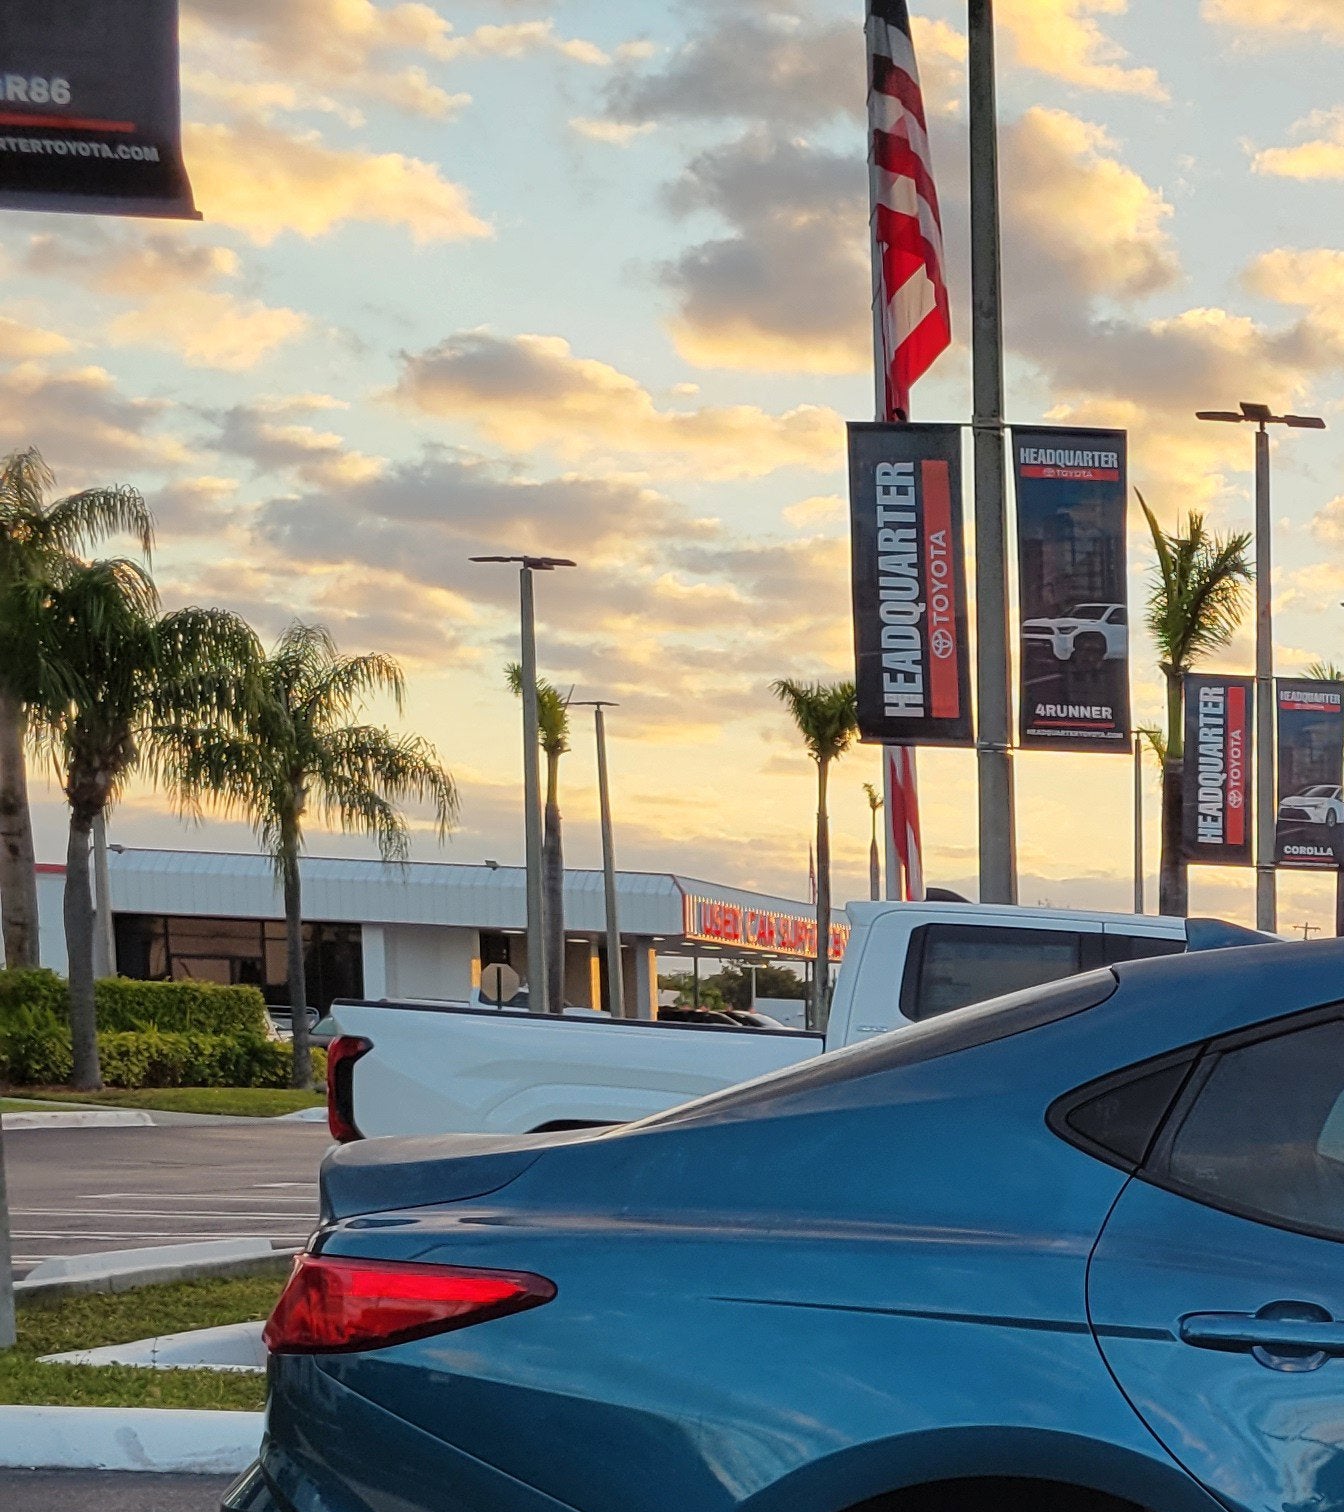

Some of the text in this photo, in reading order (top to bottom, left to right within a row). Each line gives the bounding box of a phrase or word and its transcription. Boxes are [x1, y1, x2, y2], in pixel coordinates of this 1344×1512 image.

[0, 73, 72, 105] R86
[1020, 447, 1119, 469] HEADQUARTER
[875, 461, 926, 718] HEADQUARTER
[929, 529, 952, 627] TOYOTA
[1035, 703, 1113, 719] 4RUNNER
[1198, 686, 1227, 844] HEADQUARTER
[1229, 728, 1242, 789] TOYOTA
[1283, 845, 1334, 856] COROLLA
